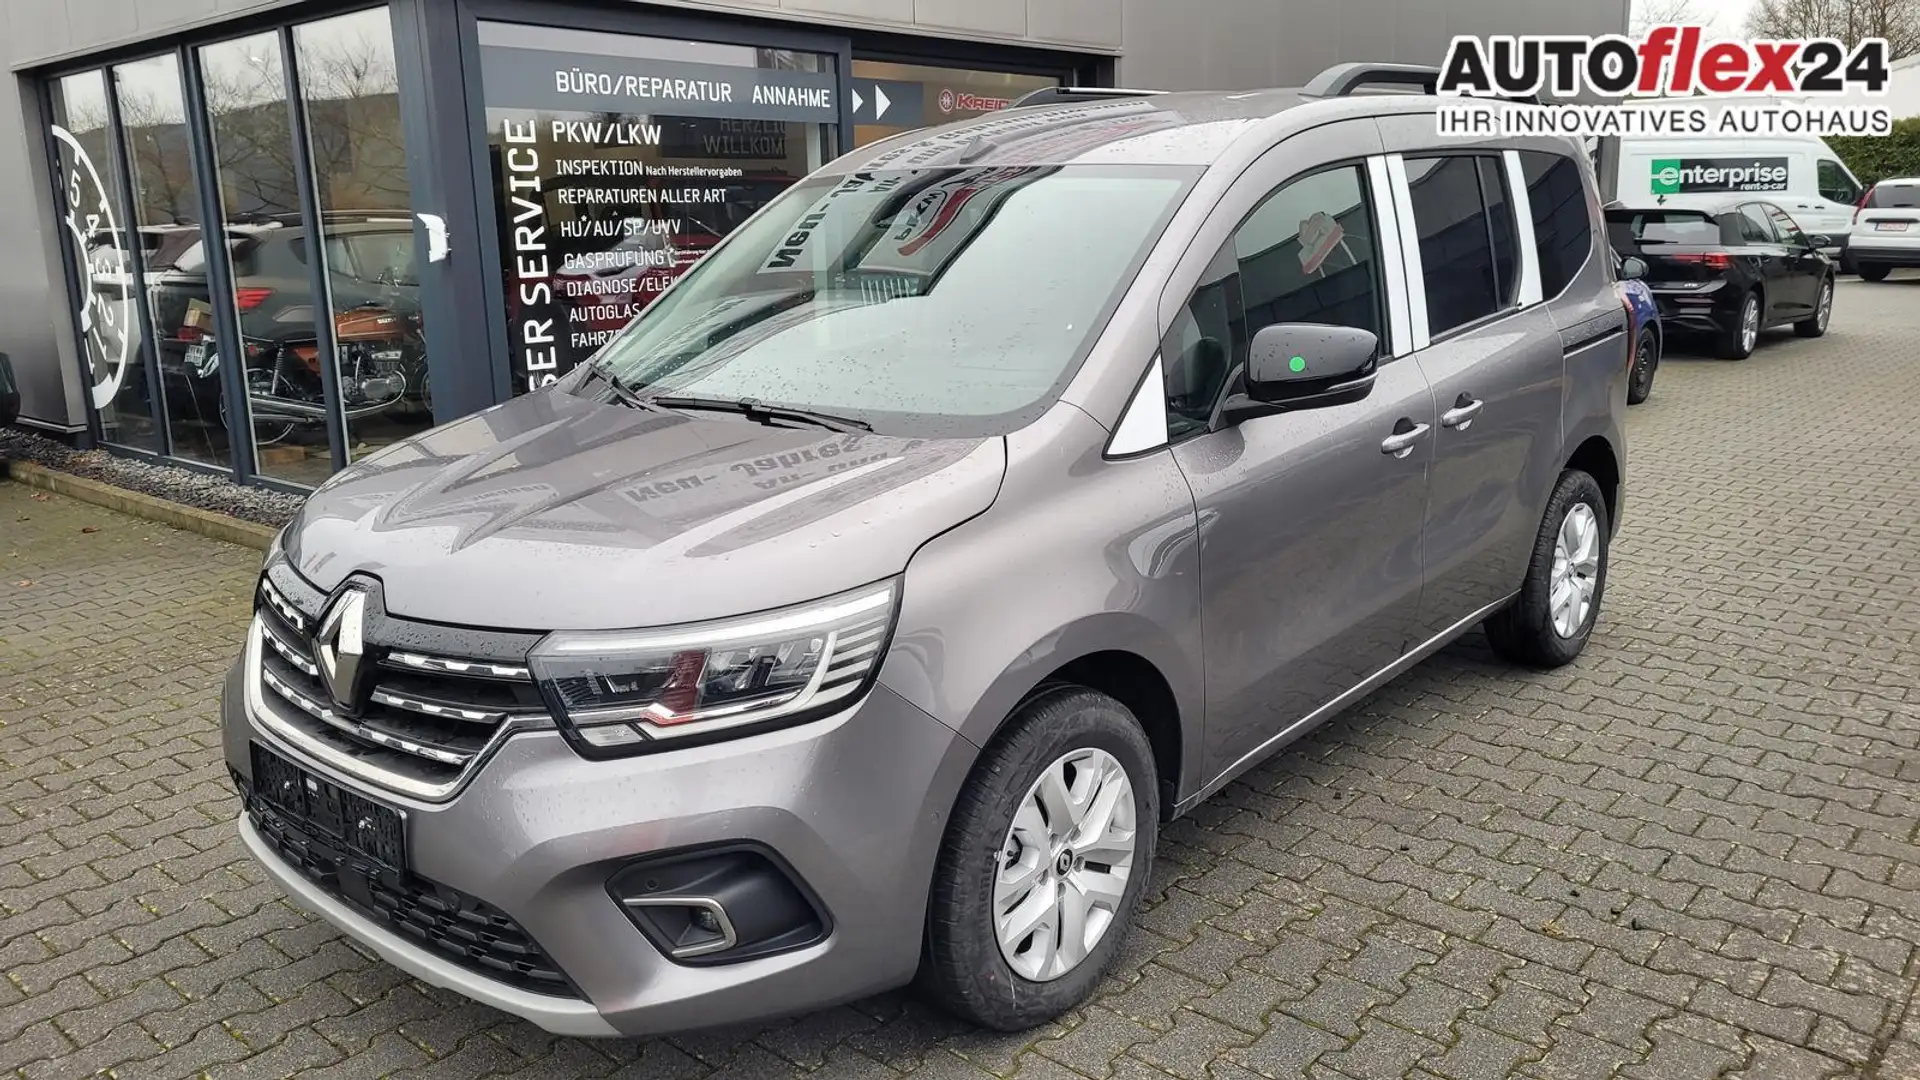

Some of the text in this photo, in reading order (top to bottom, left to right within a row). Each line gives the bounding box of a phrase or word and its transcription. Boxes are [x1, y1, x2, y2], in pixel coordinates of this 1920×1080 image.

[555, 67, 831, 108] BÜRO/REPARATUR ANNAHME
[551, 120, 661, 146] PKW/LKW
[556, 159, 743, 179] INSPEKTION Nach Herstellervorgaben
[1655, 161, 1787, 188] enterprise
[557, 188, 727, 204] REPARATUREN ALLER ART
[1740, 182, 1787, 191] rent-a-car
[504, 119, 551, 304] SERVICE
[564, 248, 664, 269] GASPRÜFUNG
[569, 303, 640, 322] AUTOGLAS
